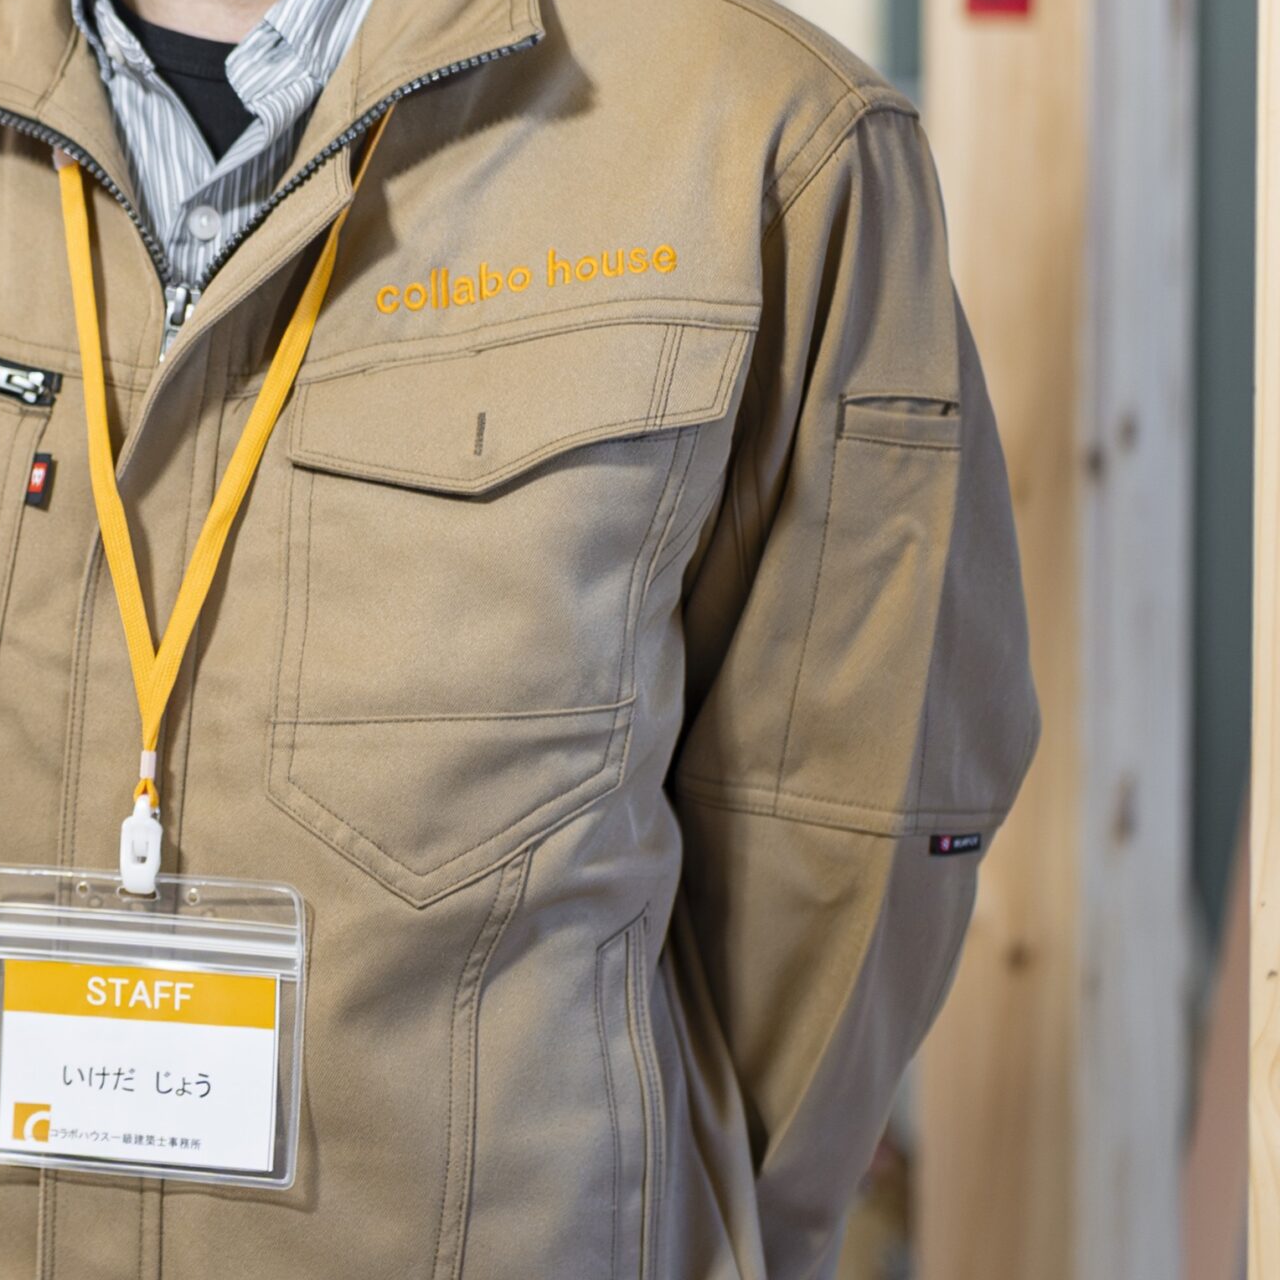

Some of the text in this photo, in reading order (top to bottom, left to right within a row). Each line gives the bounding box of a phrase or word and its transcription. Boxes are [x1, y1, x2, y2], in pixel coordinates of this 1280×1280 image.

[376, 244, 678, 314] collabo house
[86, 976, 194, 1010] STAFF
[62, 1065, 212, 1098] いけだ じょう
